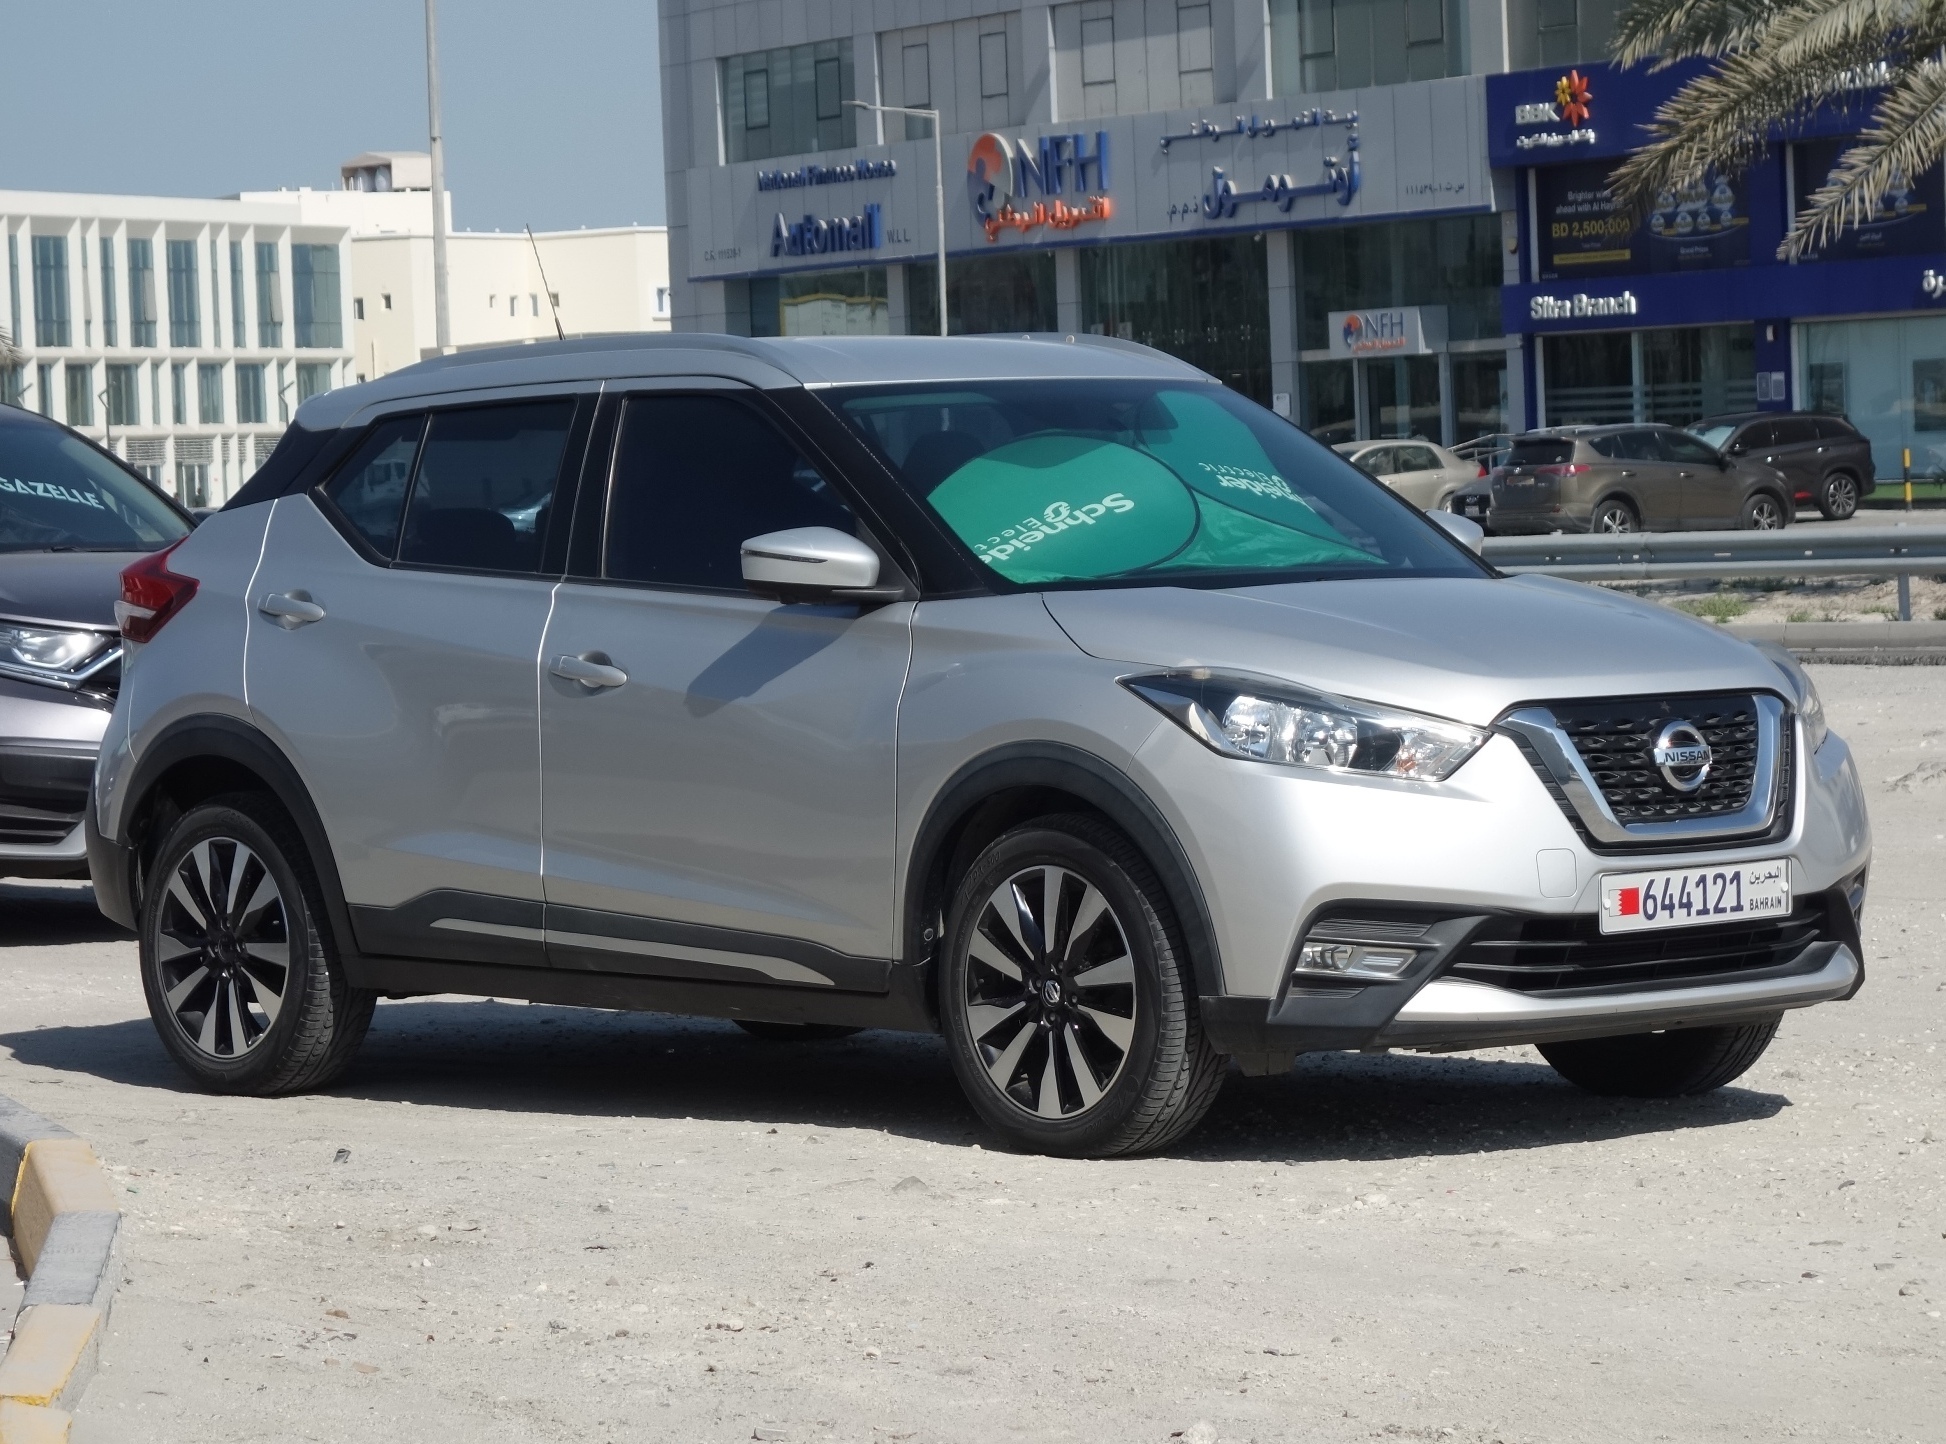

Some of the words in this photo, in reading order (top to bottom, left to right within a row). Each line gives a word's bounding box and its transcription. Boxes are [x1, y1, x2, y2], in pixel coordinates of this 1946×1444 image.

[1515, 102, 1560, 125] BBK
[757, 166, 807, 191] National
[807, 164, 856, 186] Finance
[855, 159, 897, 181] House
[1016, 131, 1109, 198] NFH
[770, 202, 882, 257] Automall
[1552, 222, 1569, 237] BD
[1530, 295, 1571, 320] Sitra
[1573, 290, 1637, 317] Branch
[1365, 312, 1404, 339] NFH
[0, 477, 105, 510] GAZELLE
[974, 517, 1042, 551] Elect
[1664, 750, 1710, 763] NISSAN
[1749, 865, 1782, 886] البحرين
[1642, 870, 1744, 921] 644121
[1749, 896, 1782, 911] BAHRAIN
